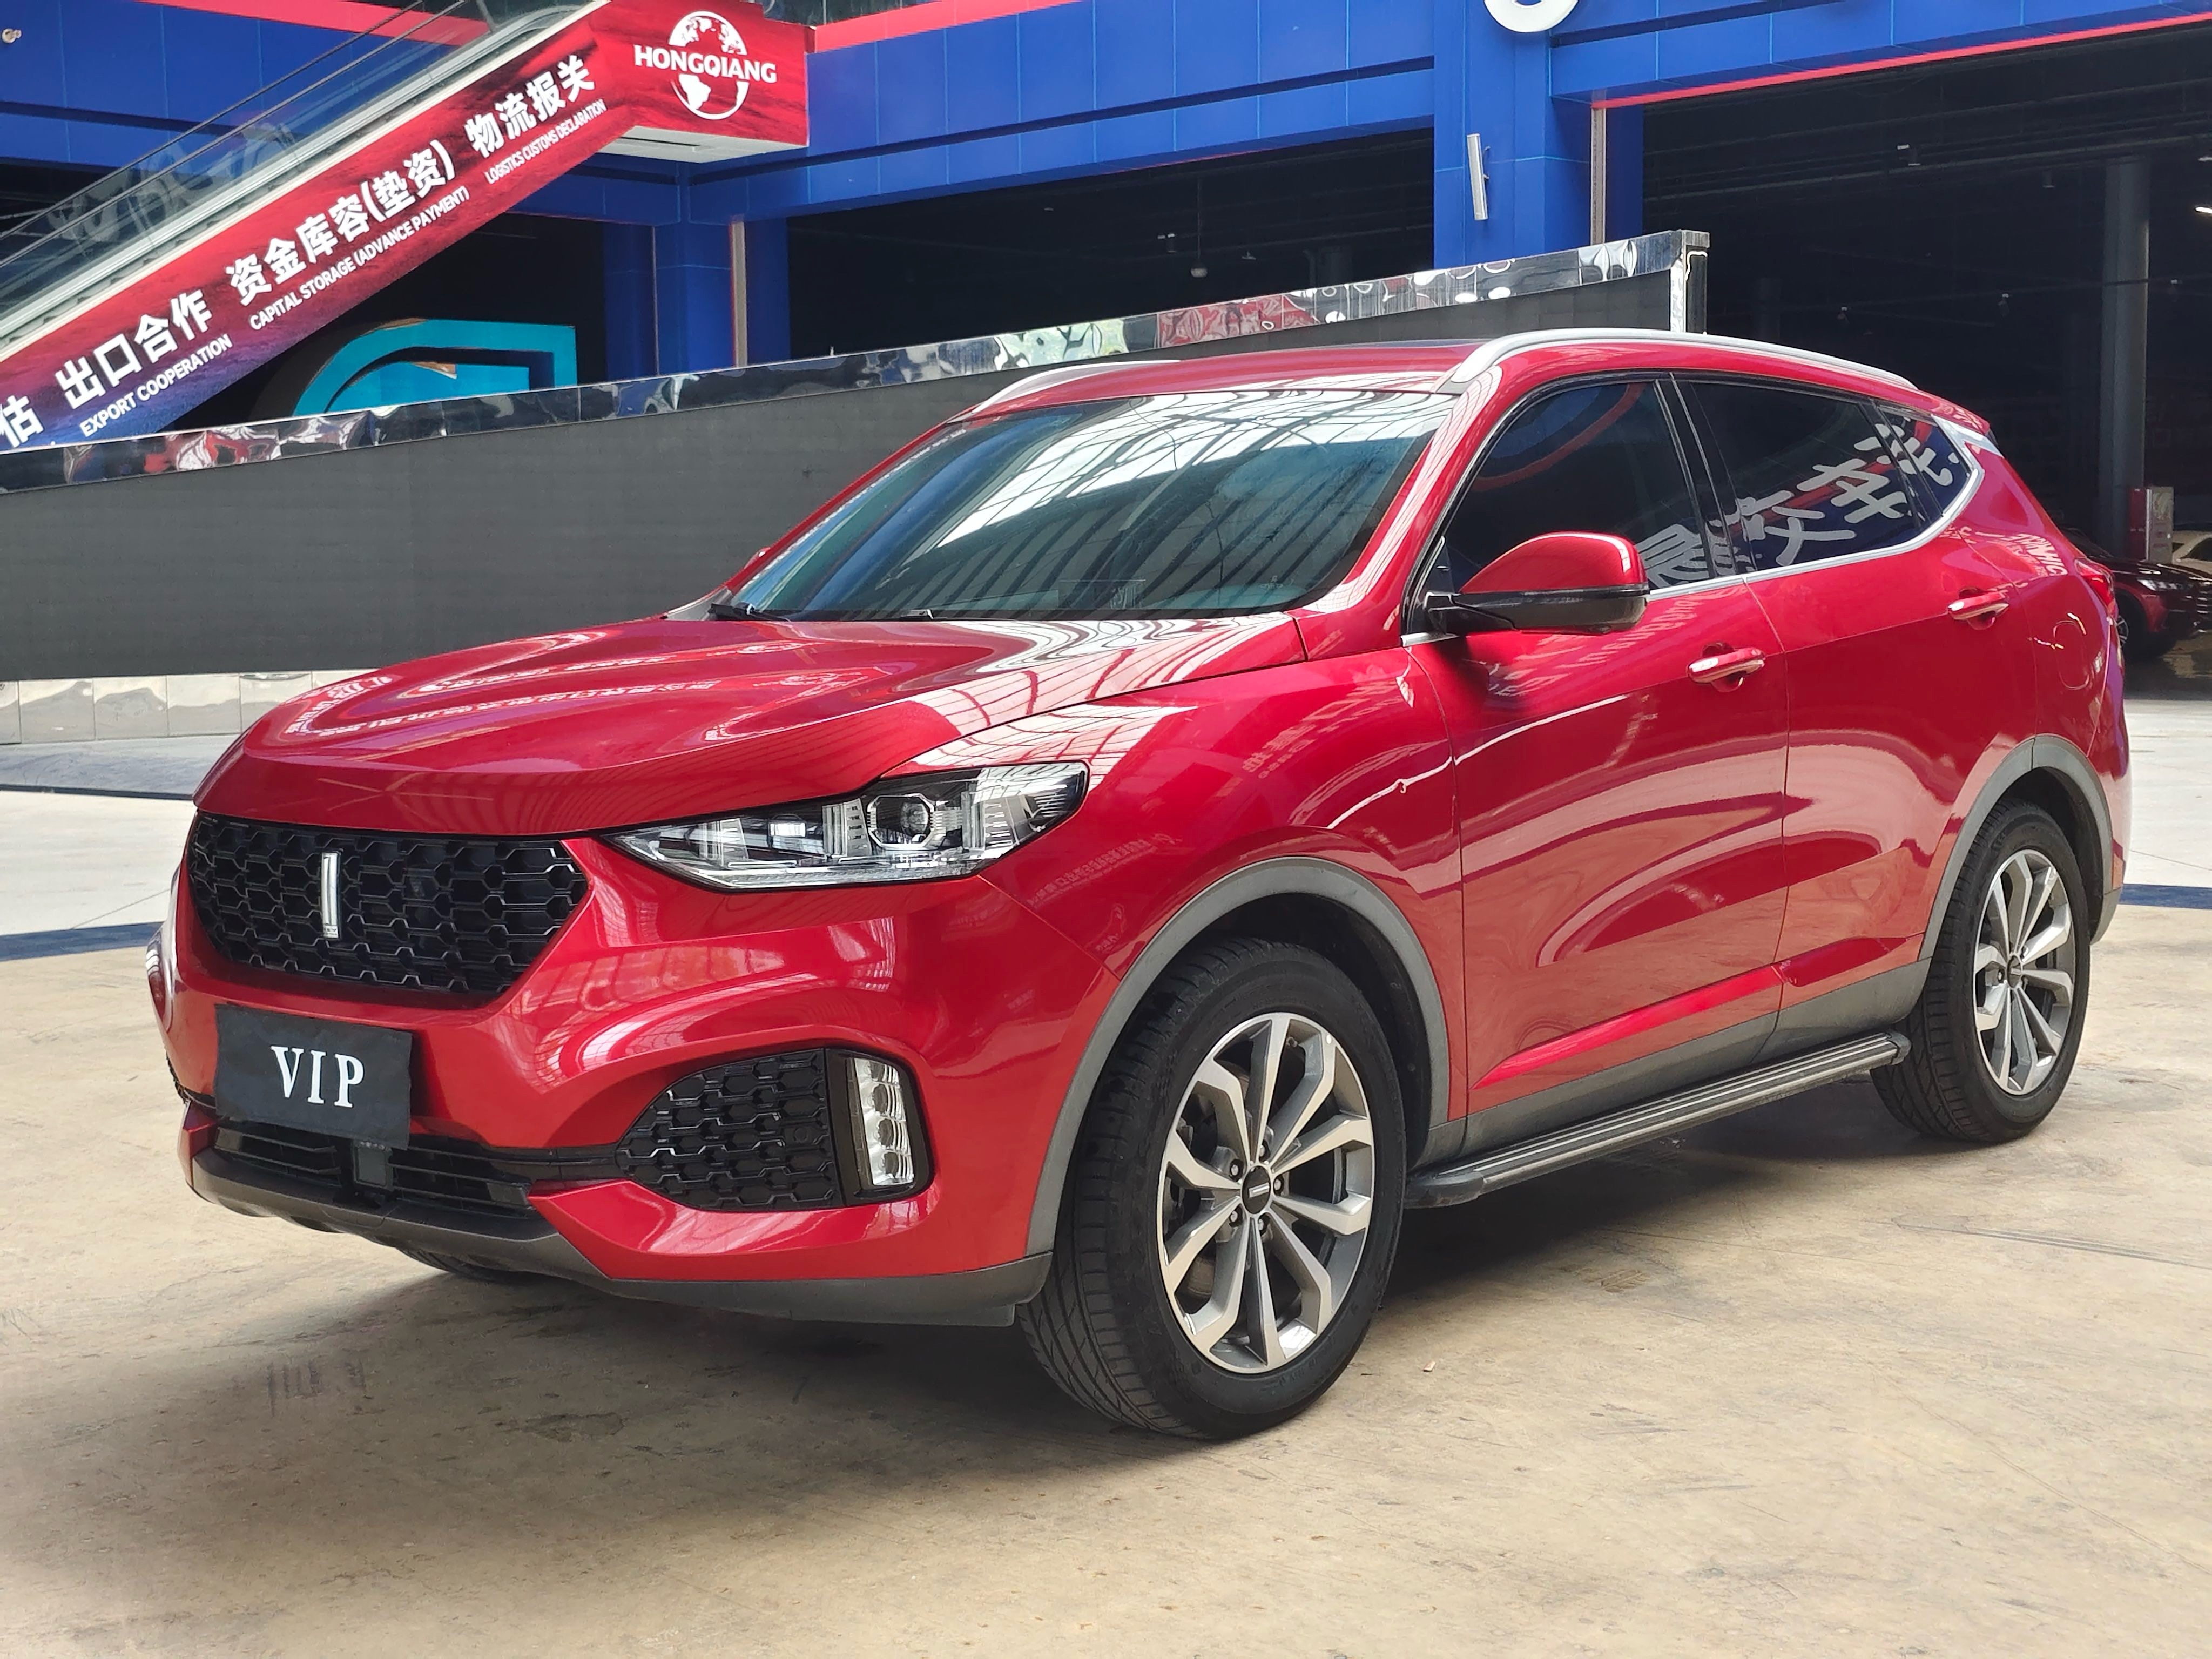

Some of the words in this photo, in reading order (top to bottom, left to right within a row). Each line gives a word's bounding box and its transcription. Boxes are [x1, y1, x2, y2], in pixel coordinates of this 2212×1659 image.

[633, 45, 777, 83] HONGQIANG
[0, 395, 44, 448] 估
[55, 289, 213, 409] 出口合作
[464, 55, 595, 158] 物流报关
[79, 392, 137, 437] EXPORT
[137, 333, 233, 401] COOPERATION
[249, 292, 302, 331] CAPITAL
[302, 257, 356, 299] STORAGE
[353, 219, 414, 266] (ADVANCE
[413, 186, 469, 232] PAYMENT)
[484, 151, 525, 184] LOGISTICS
[522, 130, 559, 160] CUSTOMS
[555, 99, 608, 139] DECLARATION
[271, 1046, 364, 1108] VIP
